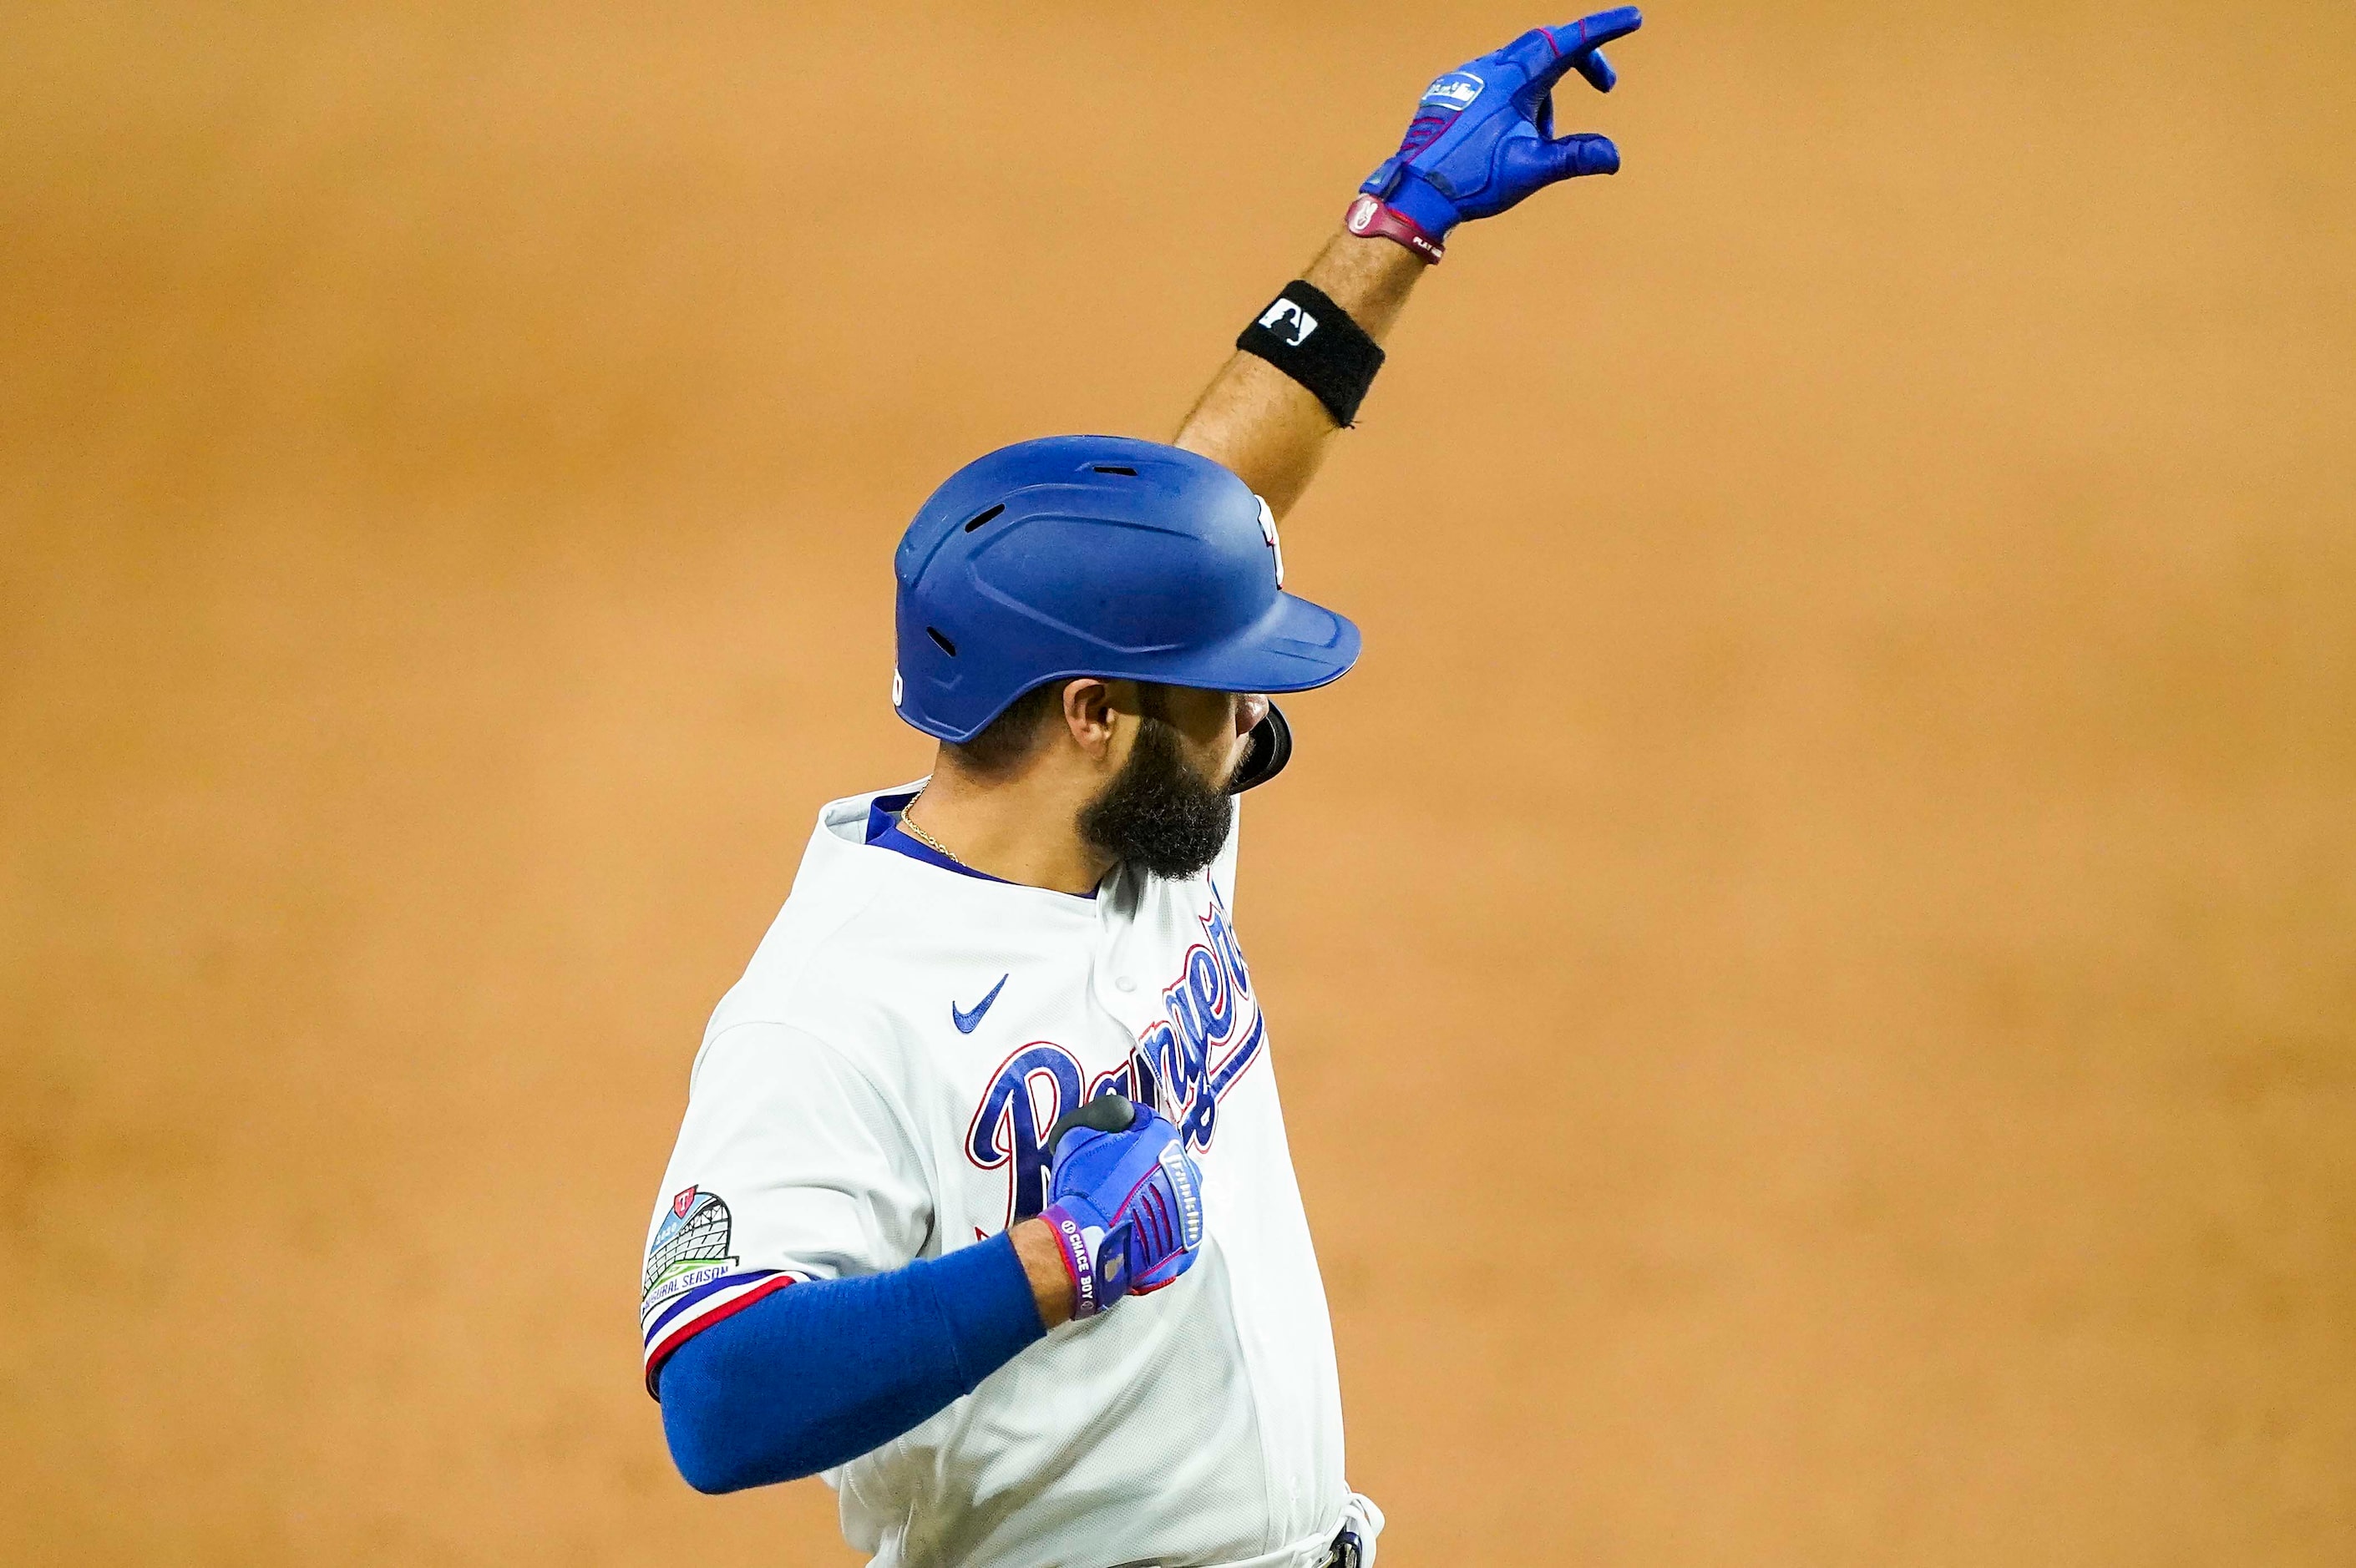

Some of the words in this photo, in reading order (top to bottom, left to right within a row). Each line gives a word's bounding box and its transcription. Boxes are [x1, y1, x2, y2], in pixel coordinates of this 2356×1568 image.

[679, 1191, 690, 1211] T
[1069, 1233, 1089, 1272] CHACE
[1081, 1275, 1093, 1298] BOY
[681, 1266, 728, 1287] SEASON
